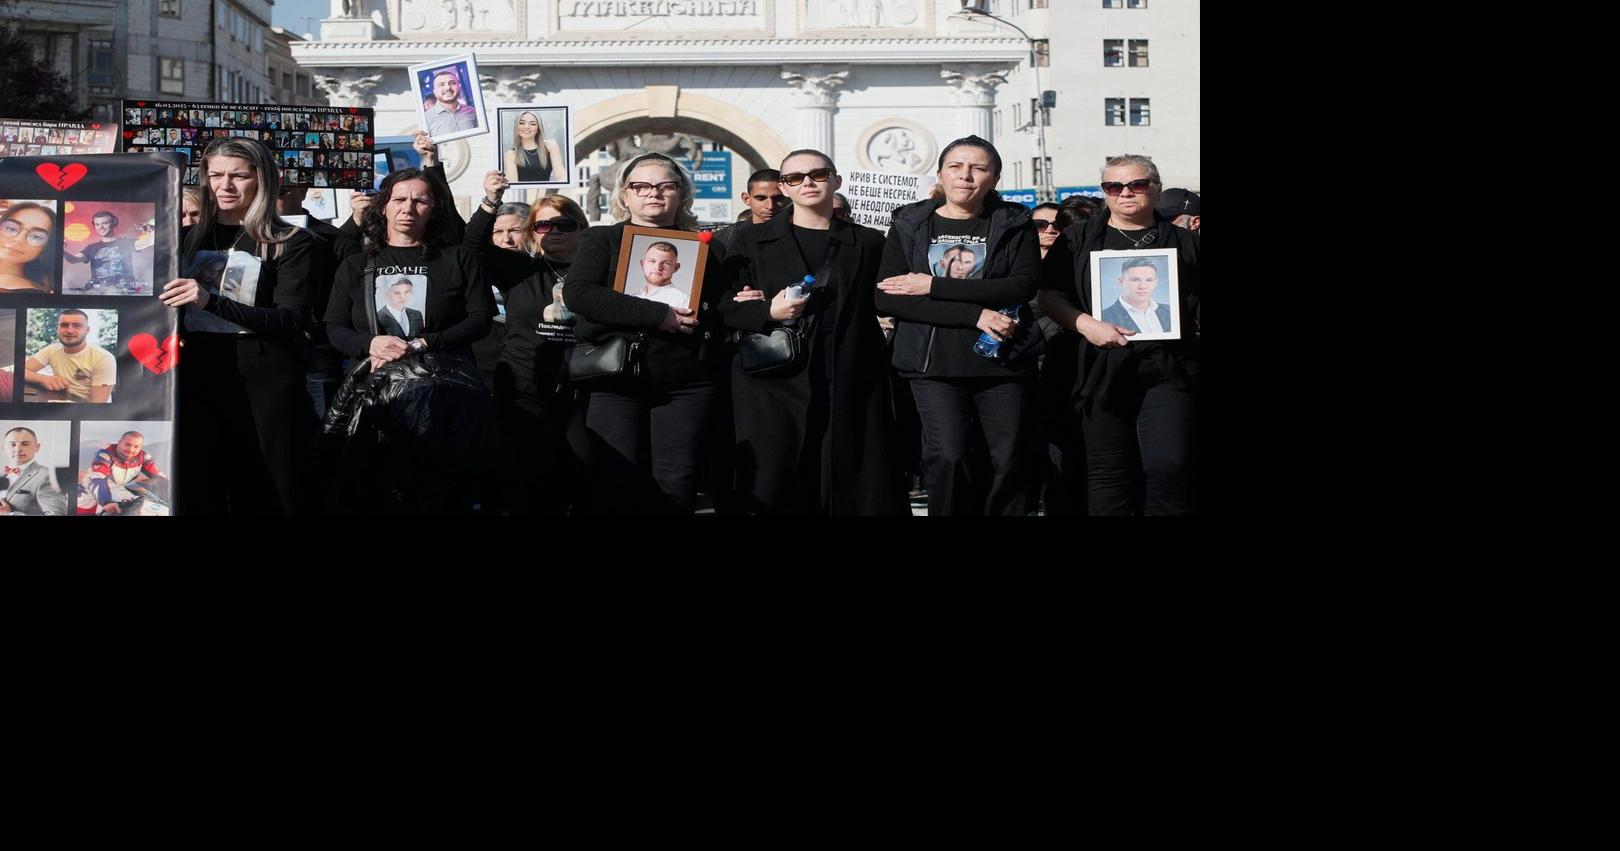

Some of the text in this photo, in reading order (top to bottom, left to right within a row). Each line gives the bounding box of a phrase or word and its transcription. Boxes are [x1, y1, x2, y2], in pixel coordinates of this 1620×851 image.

[693, 173, 726, 182] RENT
[849, 171, 919, 189] КРИВ Е СИСТЕМОТ,
[848, 185, 858, 196] НЕ
[860, 186, 882, 198] БЕШЕ
[862, 214, 872, 225] ЗА
[376, 265, 428, 275] ТОМЧЕ
